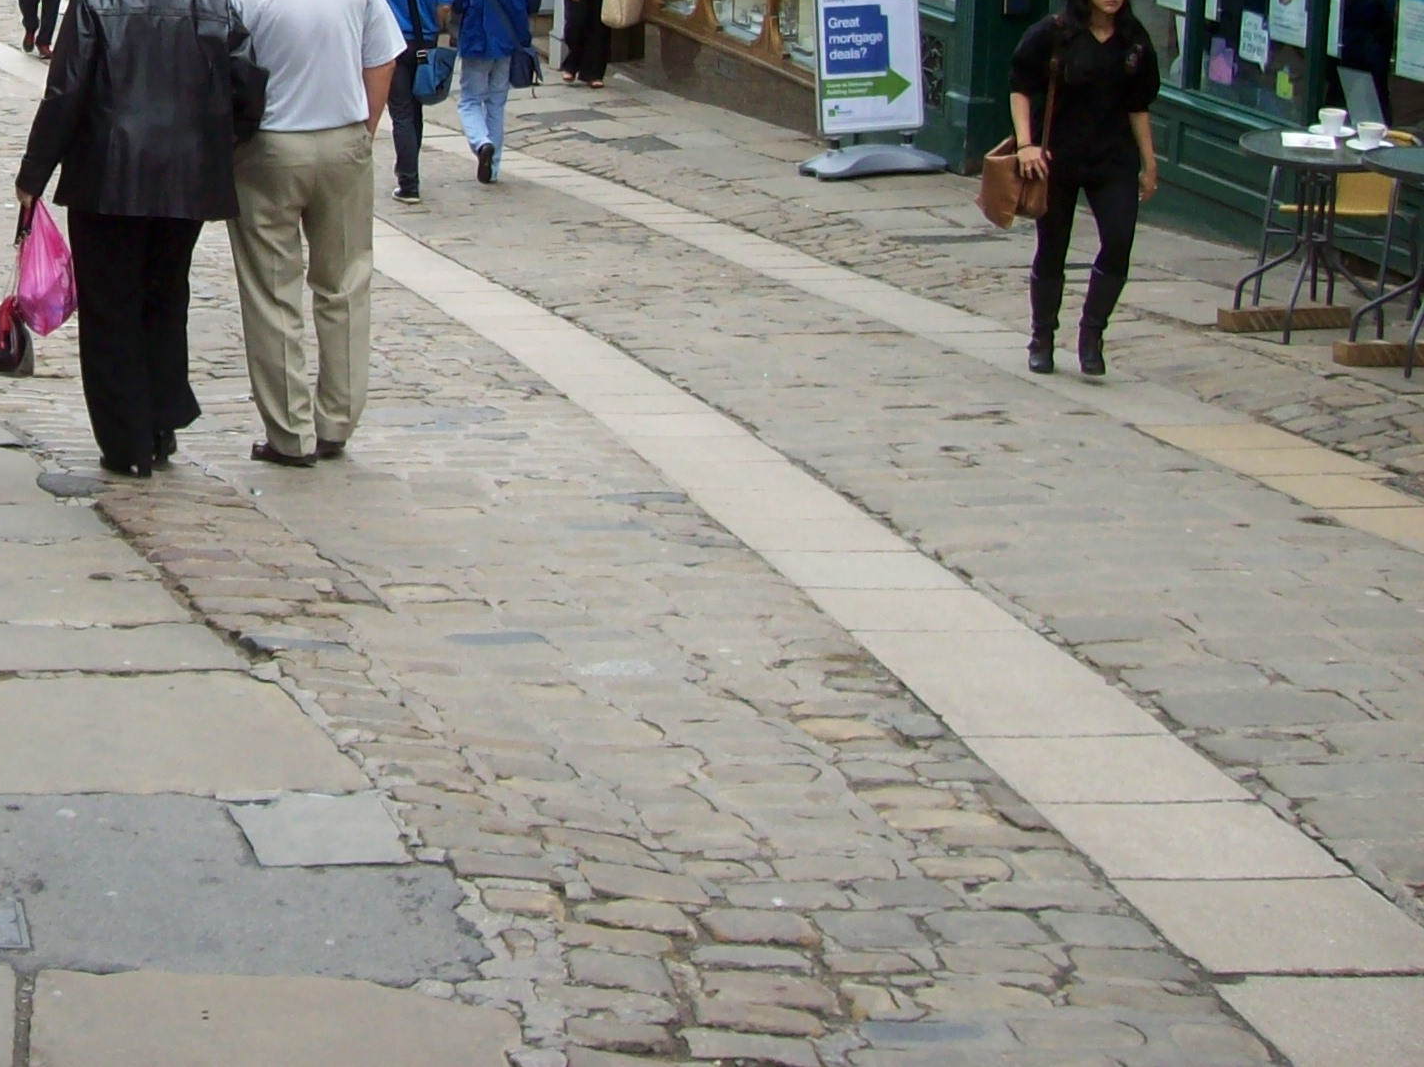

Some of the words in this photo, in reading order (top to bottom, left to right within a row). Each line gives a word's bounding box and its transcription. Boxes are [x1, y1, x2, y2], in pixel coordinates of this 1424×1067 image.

[827, 17, 860, 30] Great
[828, 32, 883, 46] mortgage
[829, 47, 867, 60] deals?
